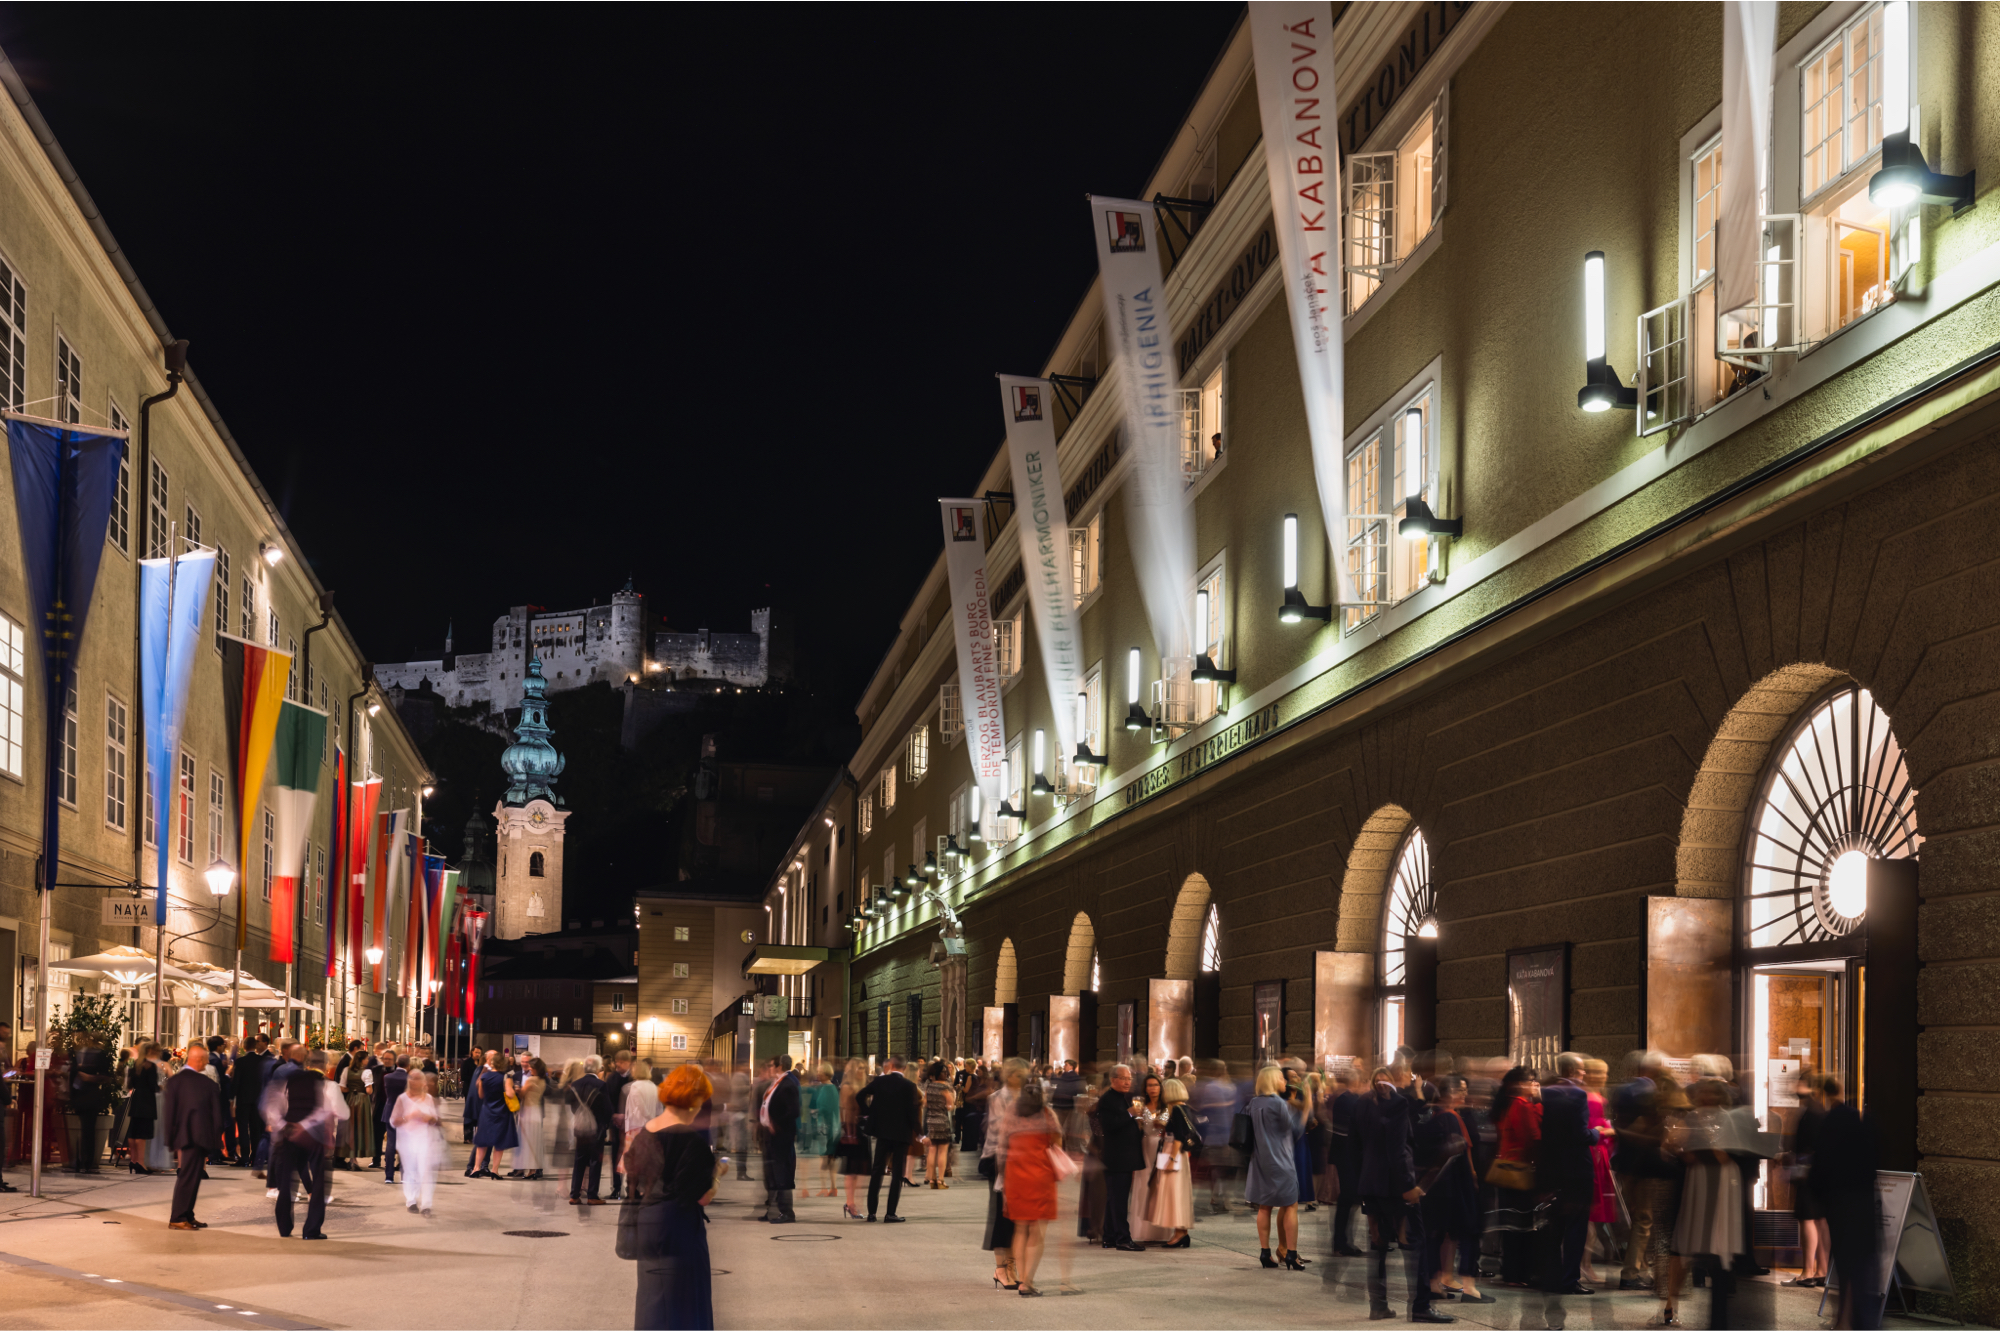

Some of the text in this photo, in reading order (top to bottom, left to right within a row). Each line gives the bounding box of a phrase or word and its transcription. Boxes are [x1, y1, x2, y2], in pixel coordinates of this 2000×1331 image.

[1283, 17, 1327, 231] KABANOVÁ
[1026, 450, 1070, 632] PHILHARMONIKER
[967, 602, 991, 777] HERZOG BLAUBARTS BURG
[974, 567, 1001, 777] DE TEMPORUM FINE COMOEDIA
[1126, 703, 1279, 804] GROSSES FESTSPIELHAUS
[114, 903, 148, 916] NAYA
